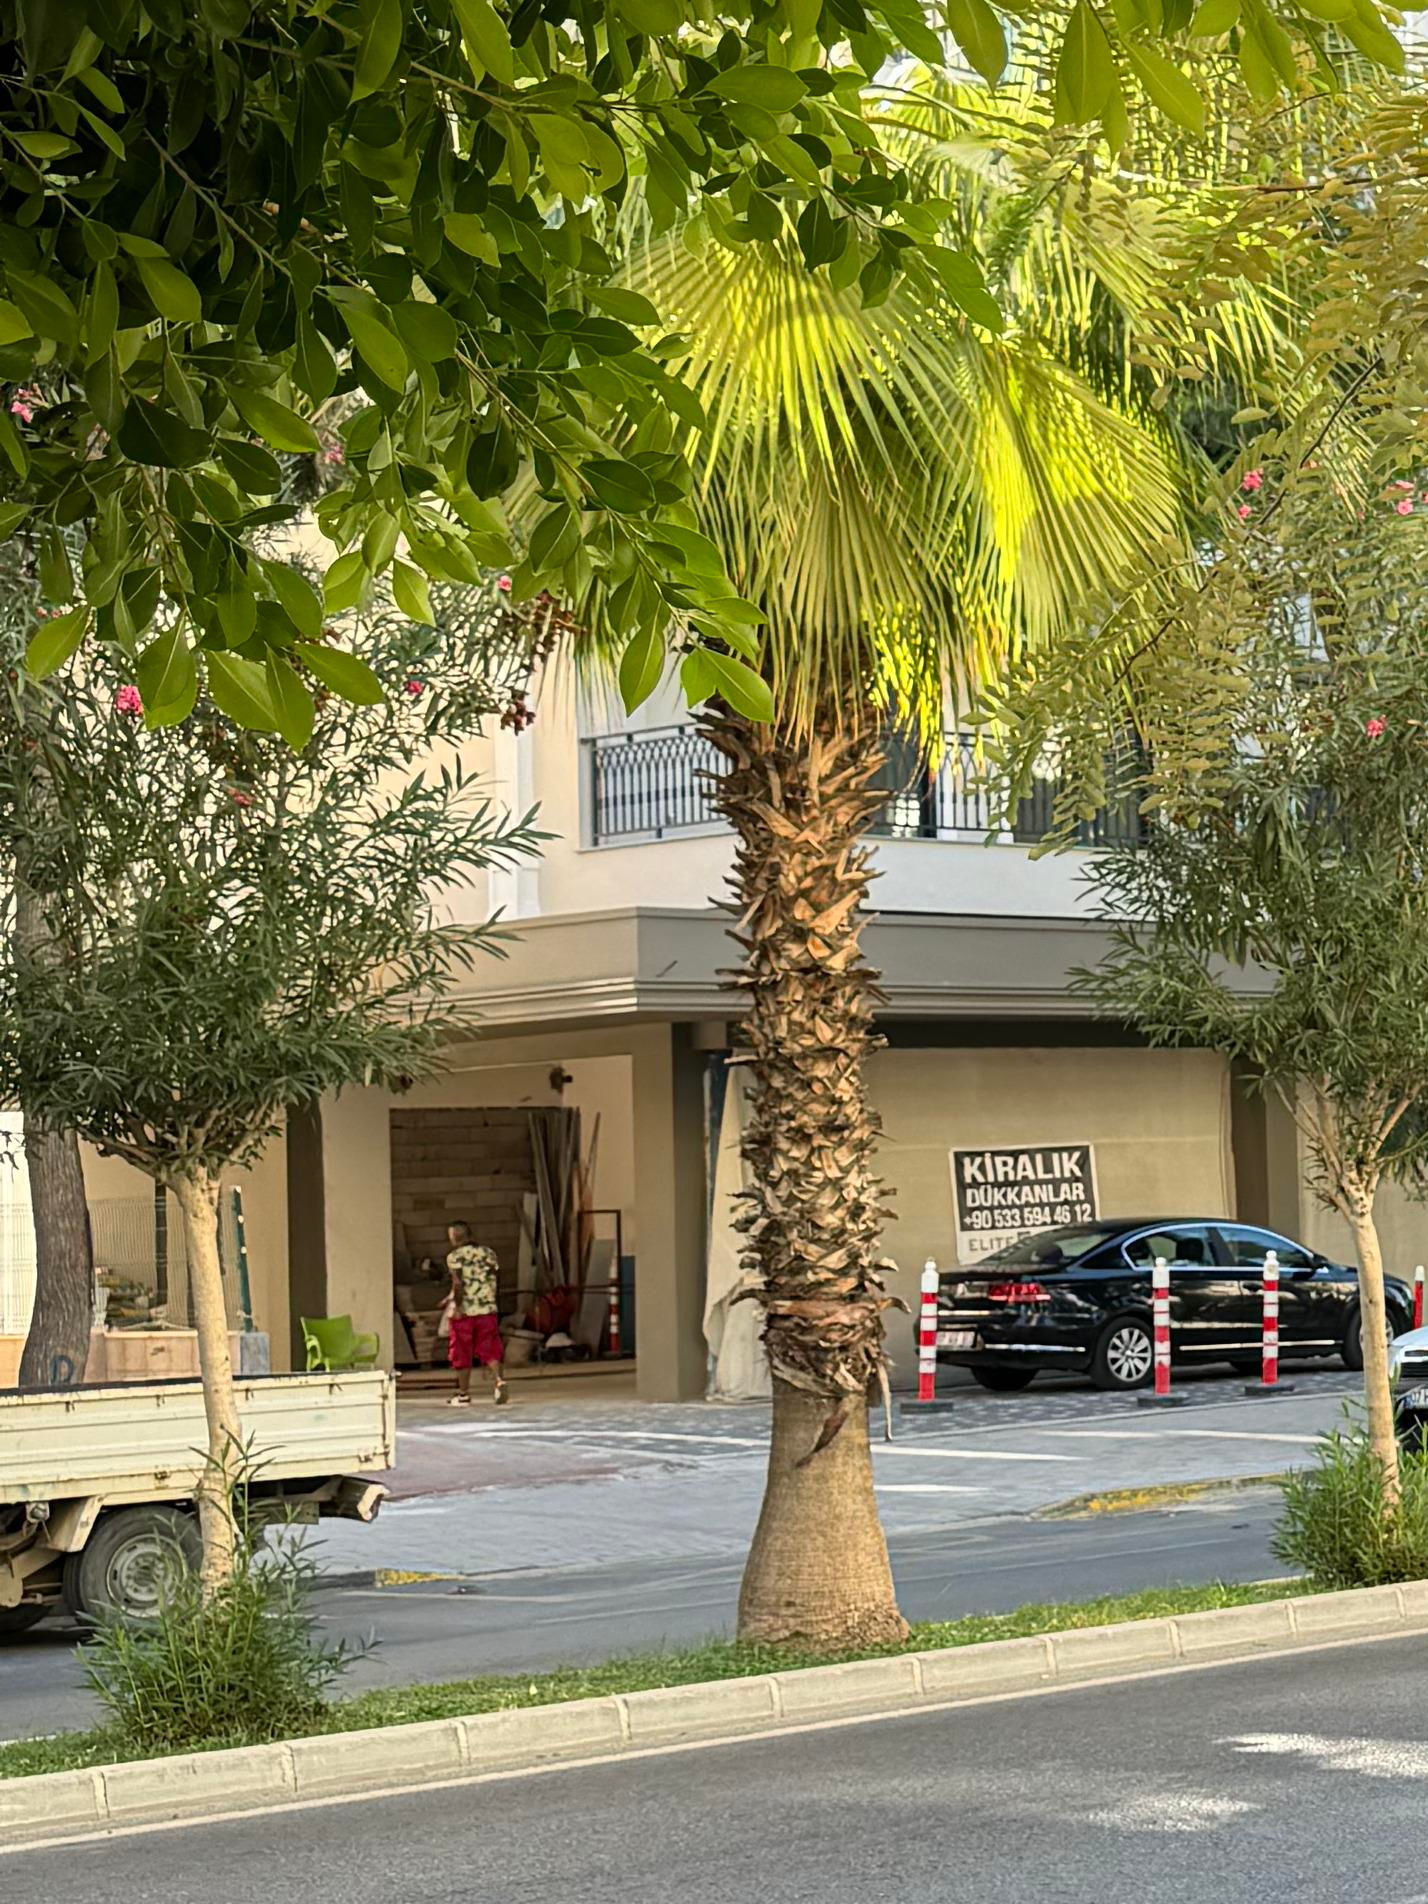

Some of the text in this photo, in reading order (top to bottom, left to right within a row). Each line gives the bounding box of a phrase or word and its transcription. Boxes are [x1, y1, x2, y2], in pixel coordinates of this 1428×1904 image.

[963, 1151, 1083, 1183] KİRALIK
[965, 1182, 1086, 1208] DÜKKANLAR
[963, 1203, 1093, 1229] +90 533 594 46 12
